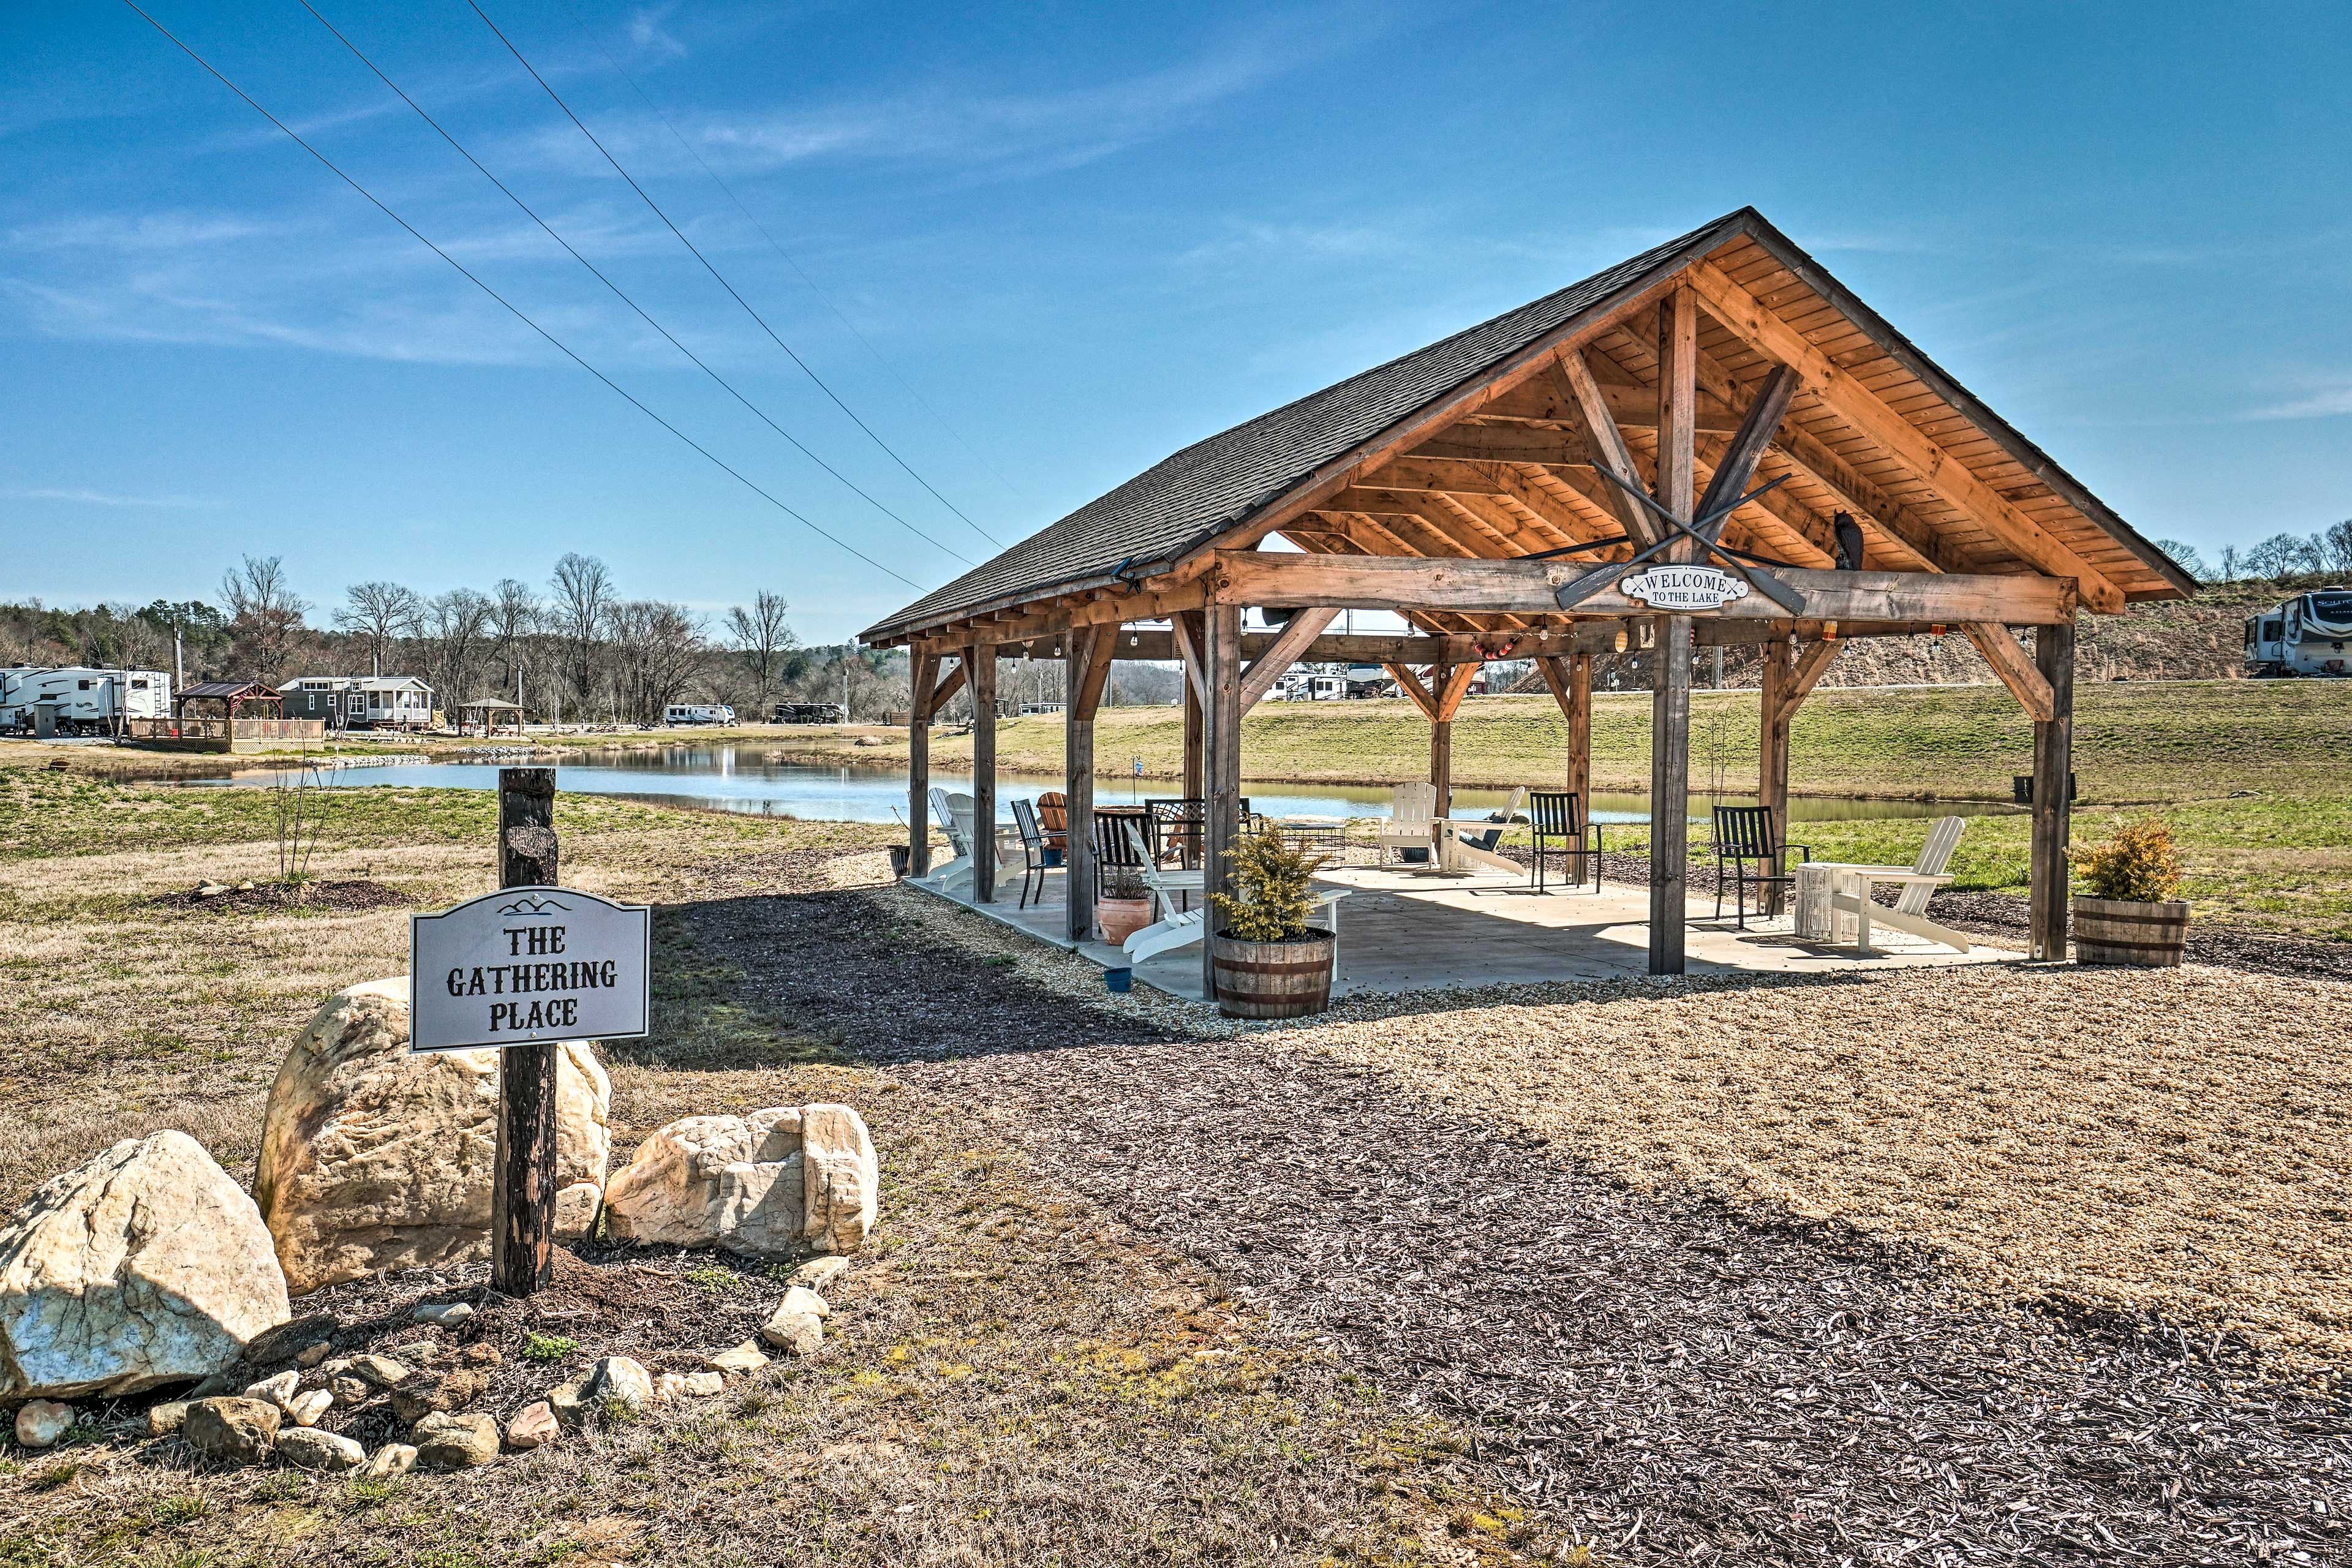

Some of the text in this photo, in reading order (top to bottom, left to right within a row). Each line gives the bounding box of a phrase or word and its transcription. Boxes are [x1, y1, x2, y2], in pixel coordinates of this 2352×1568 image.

[1645, 573, 1727, 592] WELCOME
[1653, 592, 1719, 603] TO THE LAKE
[503, 925, 566, 956] THE
[446, 960, 618, 997] GATHERING
[489, 998, 578, 1031] PLACE
